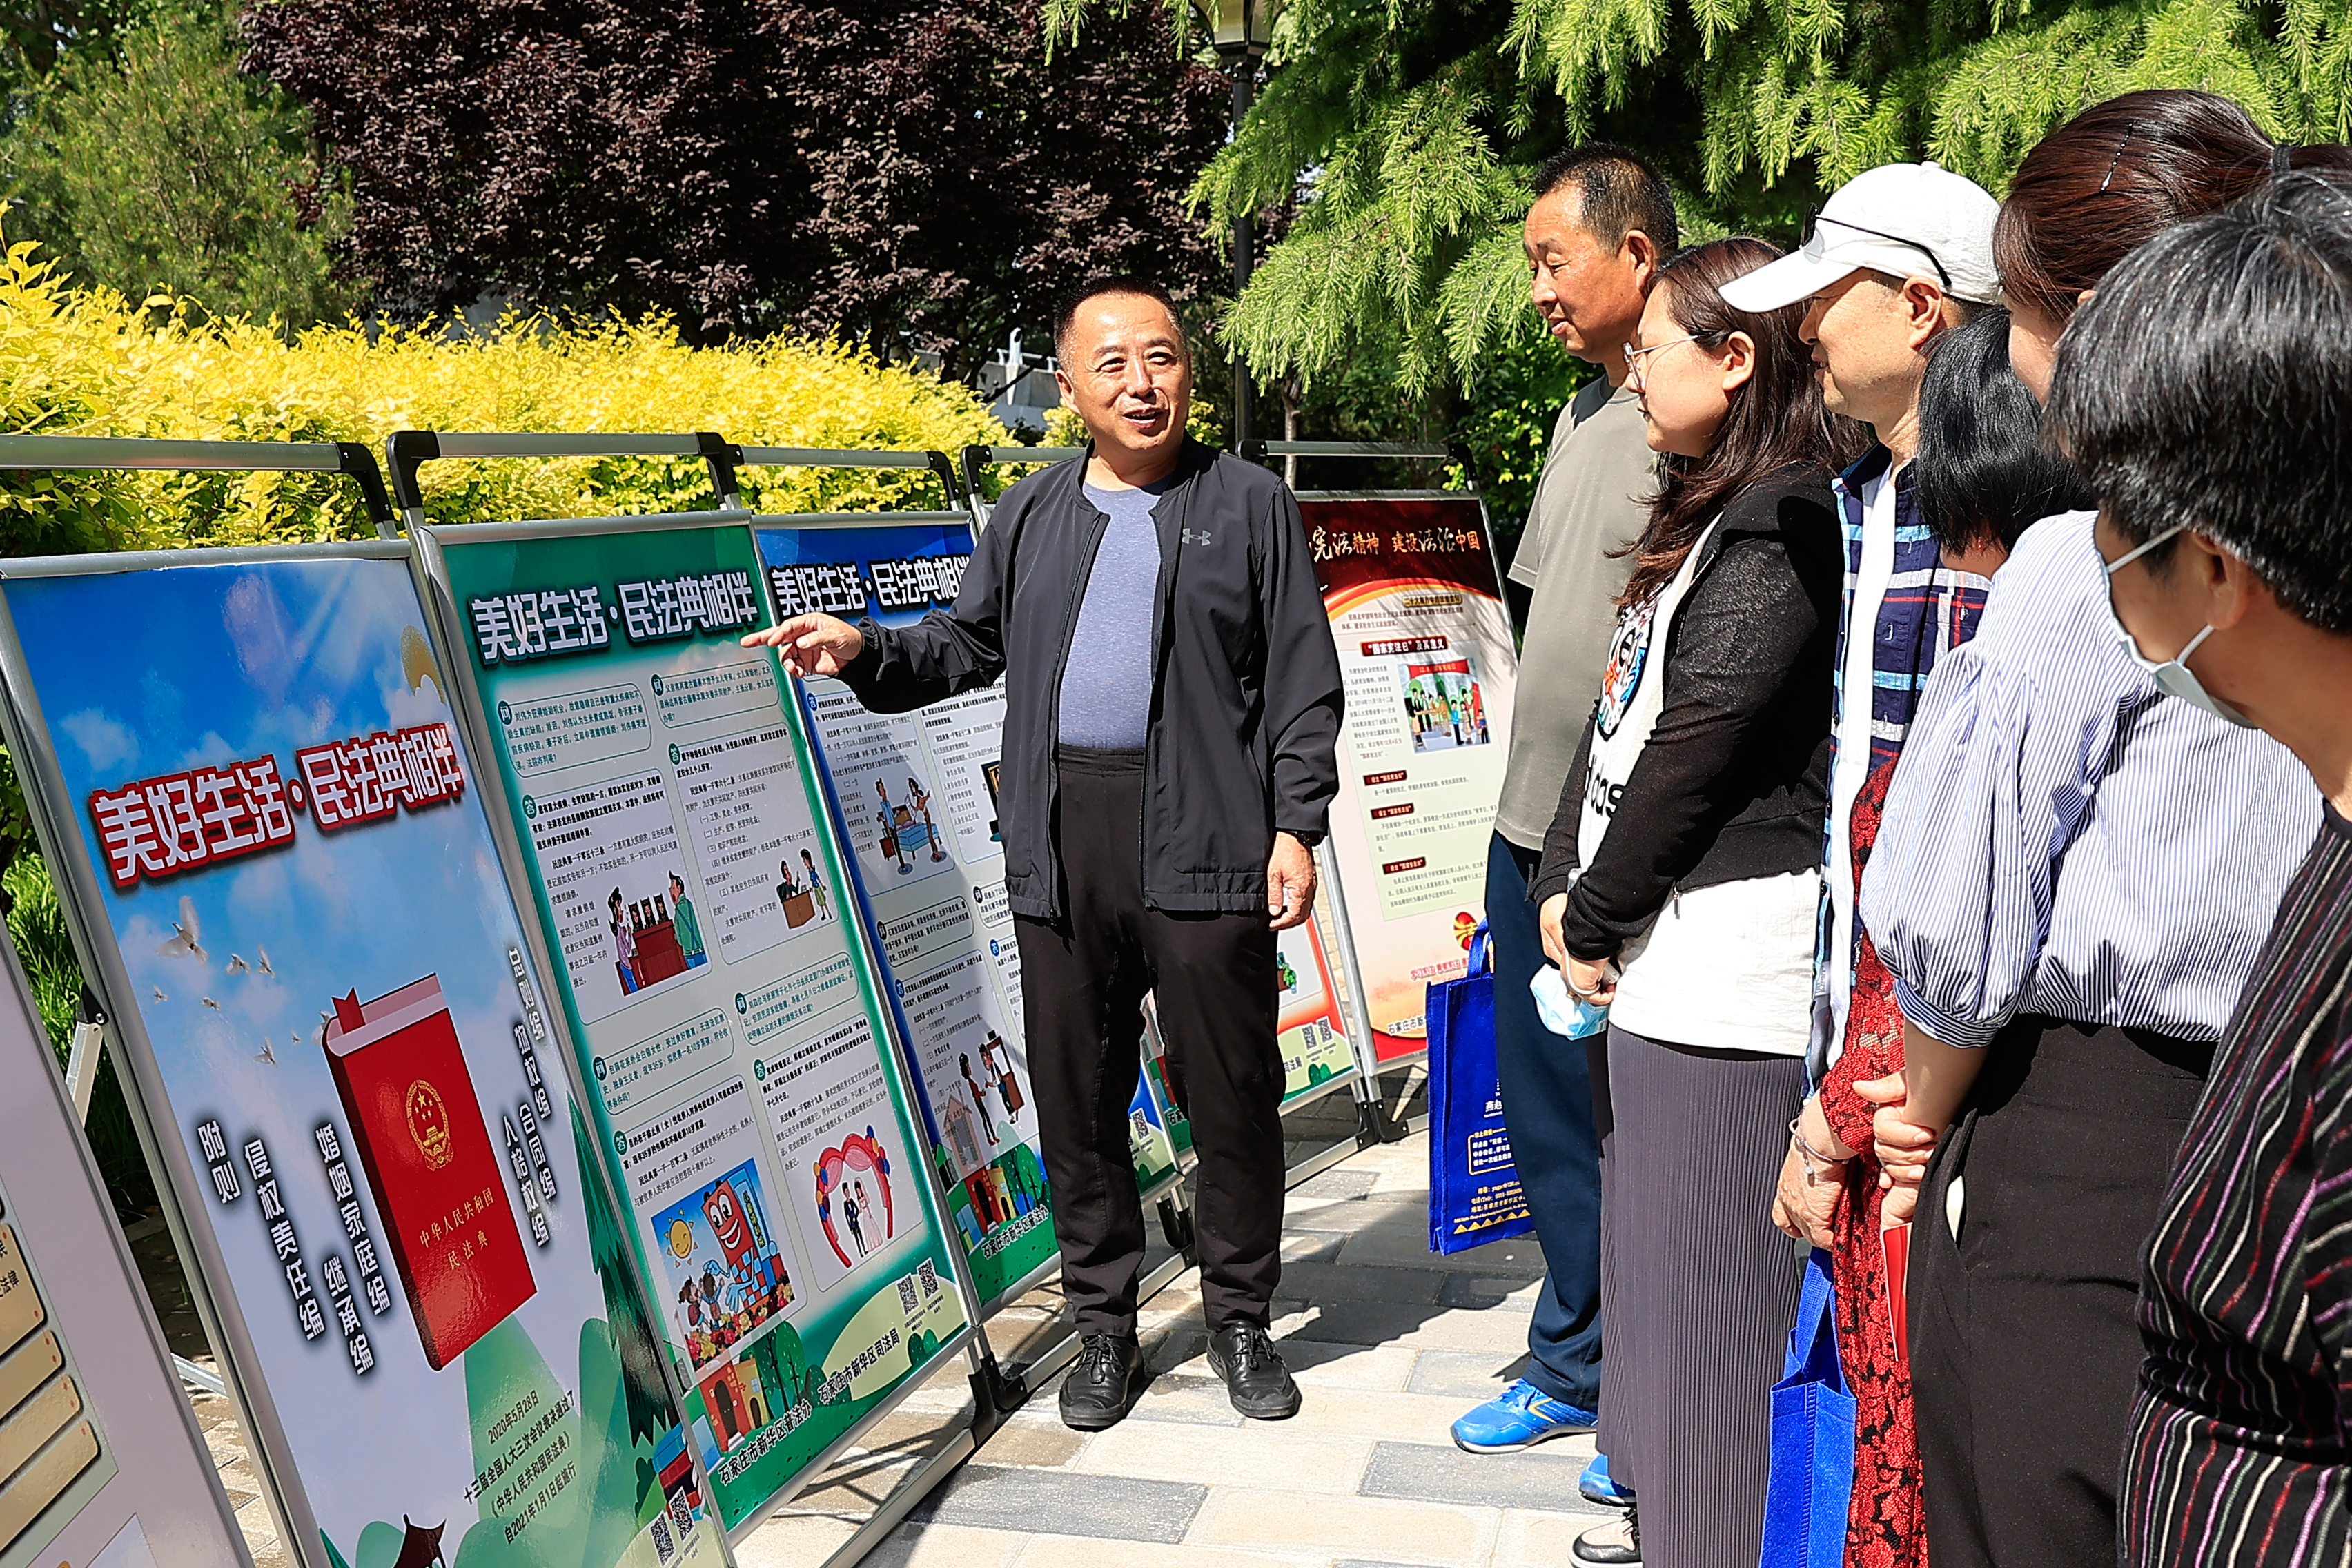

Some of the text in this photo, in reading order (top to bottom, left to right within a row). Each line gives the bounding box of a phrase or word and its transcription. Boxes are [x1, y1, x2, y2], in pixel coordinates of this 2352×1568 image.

[1309, 525, 1481, 563] 宪法精神 建设法治中国
[471, 571, 758, 660] 美好生活·民法典相伴
[499, 705, 511, 721] 问
[669, 746, 680, 762] 答
[95, 727, 461, 881] 美好生活·民法典相伴
[523, 798, 536, 815] 答
[514, 1024, 551, 1119] 物权编
[197, 1120, 241, 1204] 附则
[503, 1114, 550, 1247] 人格权编
[518, 1104, 558, 1200] 合同编
[615, 1133, 627, 1152] 答
[244, 1139, 326, 1340] 侵权责任编
[315, 1123, 391, 1315] 婚姻家庭编
[419, 1187, 495, 1248] 中华人民共和国
[447, 1230, 489, 1270] 民法典
[983, 1206, 1050, 1260] 石家庄市新华区普法办
[323, 1256, 375, 1375] 继承编
[464, 1390, 576, 1506] 十三届全国人大三次会议表决通过了
[487, 1390, 539, 1444] 2020年5月28日
[716, 1325, 901, 1487] 石家庄市新华区普法办 石家庄市新华区司法局
[491, 1433, 571, 1518] 《中华人民共和国民法典》
[504, 1460, 578, 1545] 自2021年1月1日起施行
